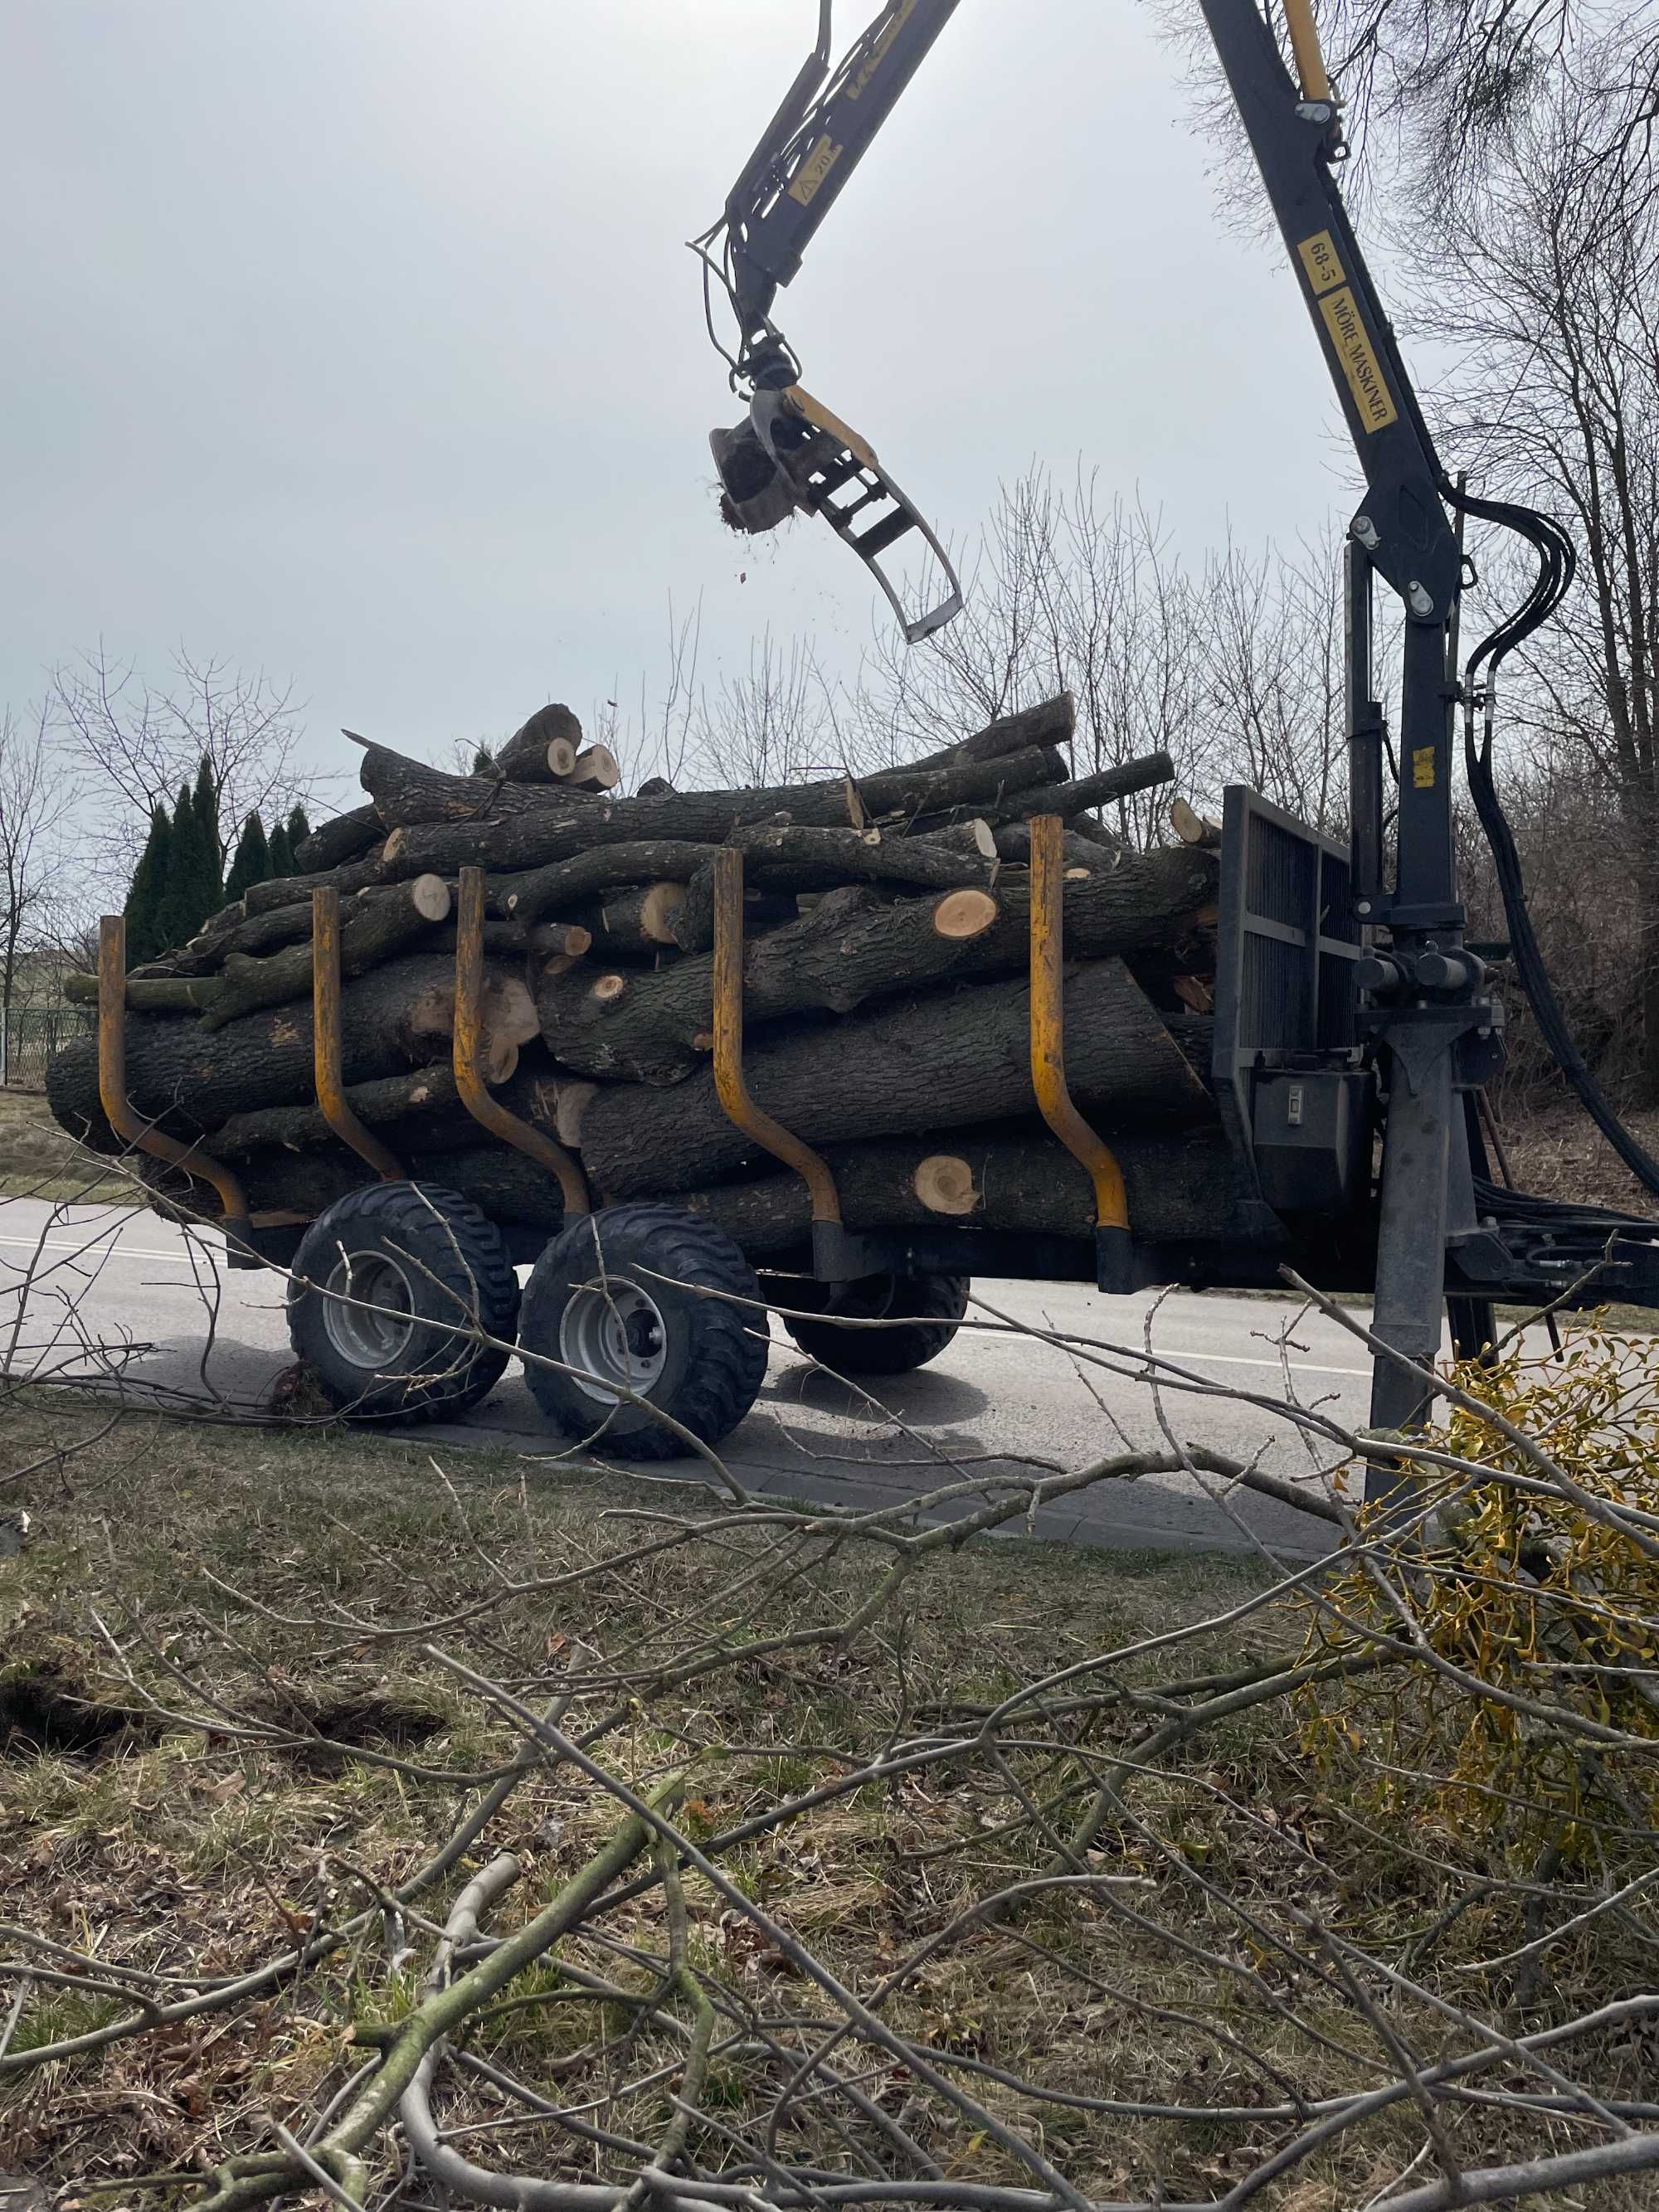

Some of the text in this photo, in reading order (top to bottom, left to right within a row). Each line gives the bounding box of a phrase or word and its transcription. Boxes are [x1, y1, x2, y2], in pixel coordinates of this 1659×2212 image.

[1311, 242, 1336, 281] 68-5
[1332, 298, 1388, 421] MÖRE MASKINER
